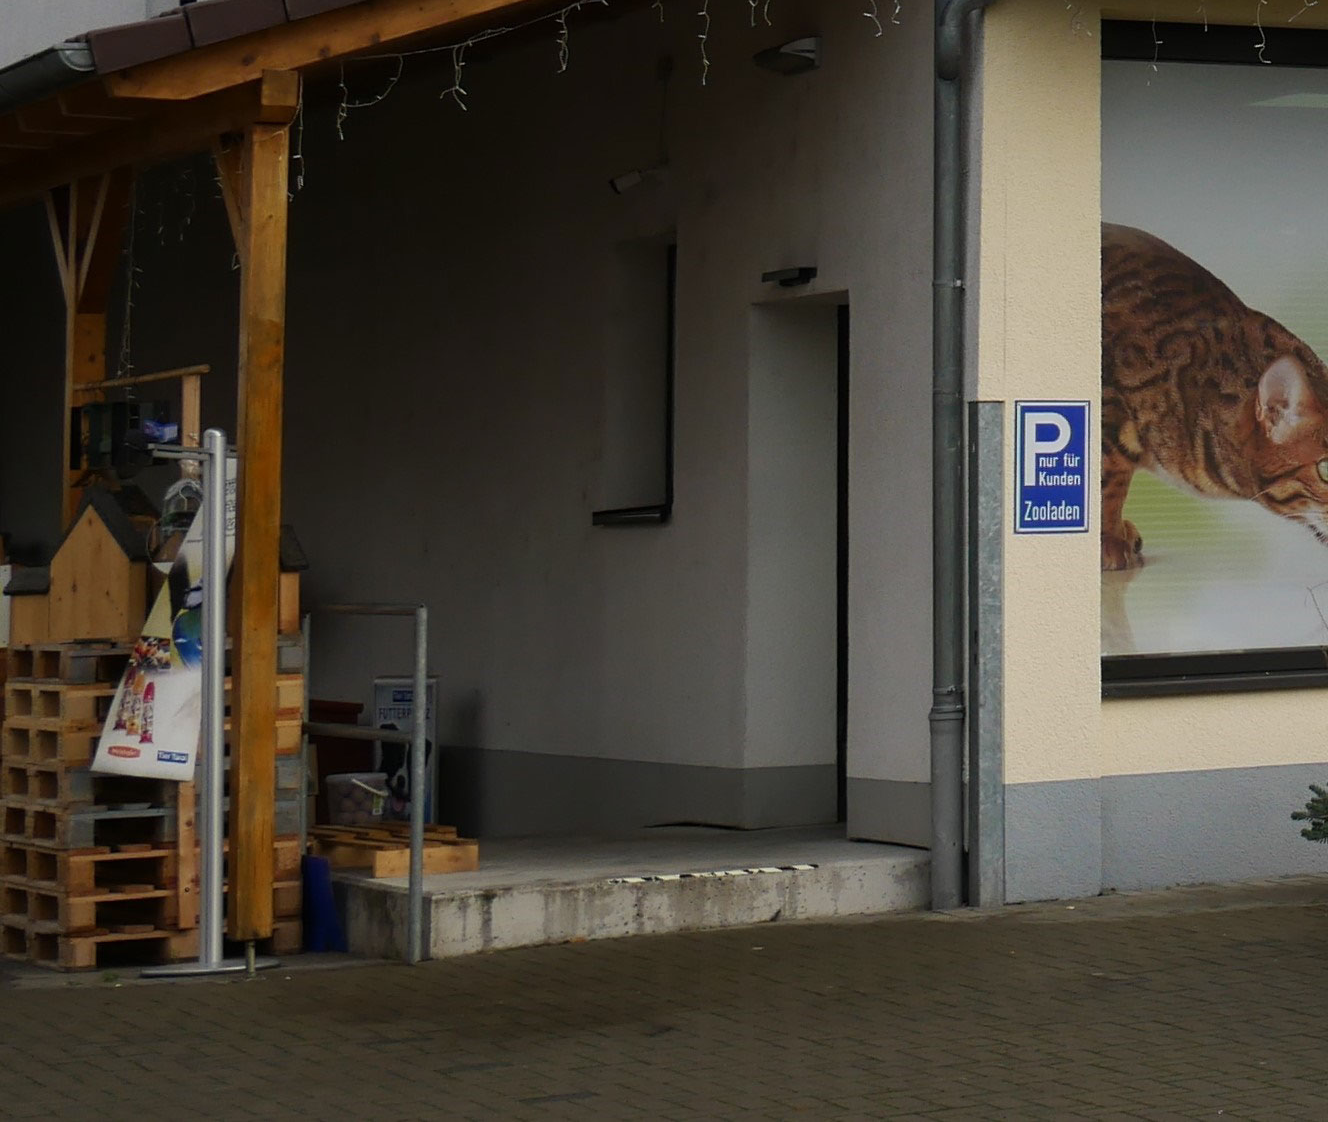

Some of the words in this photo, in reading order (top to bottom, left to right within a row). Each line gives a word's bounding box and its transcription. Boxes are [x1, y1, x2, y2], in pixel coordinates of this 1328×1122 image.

[1024, 412, 1072, 486] P
[1039, 455, 1058, 467] nur
[1063, 452, 1080, 467] für
[1039, 472, 1081, 486] Kunden
[1024, 500, 1080, 521] Zooladen
